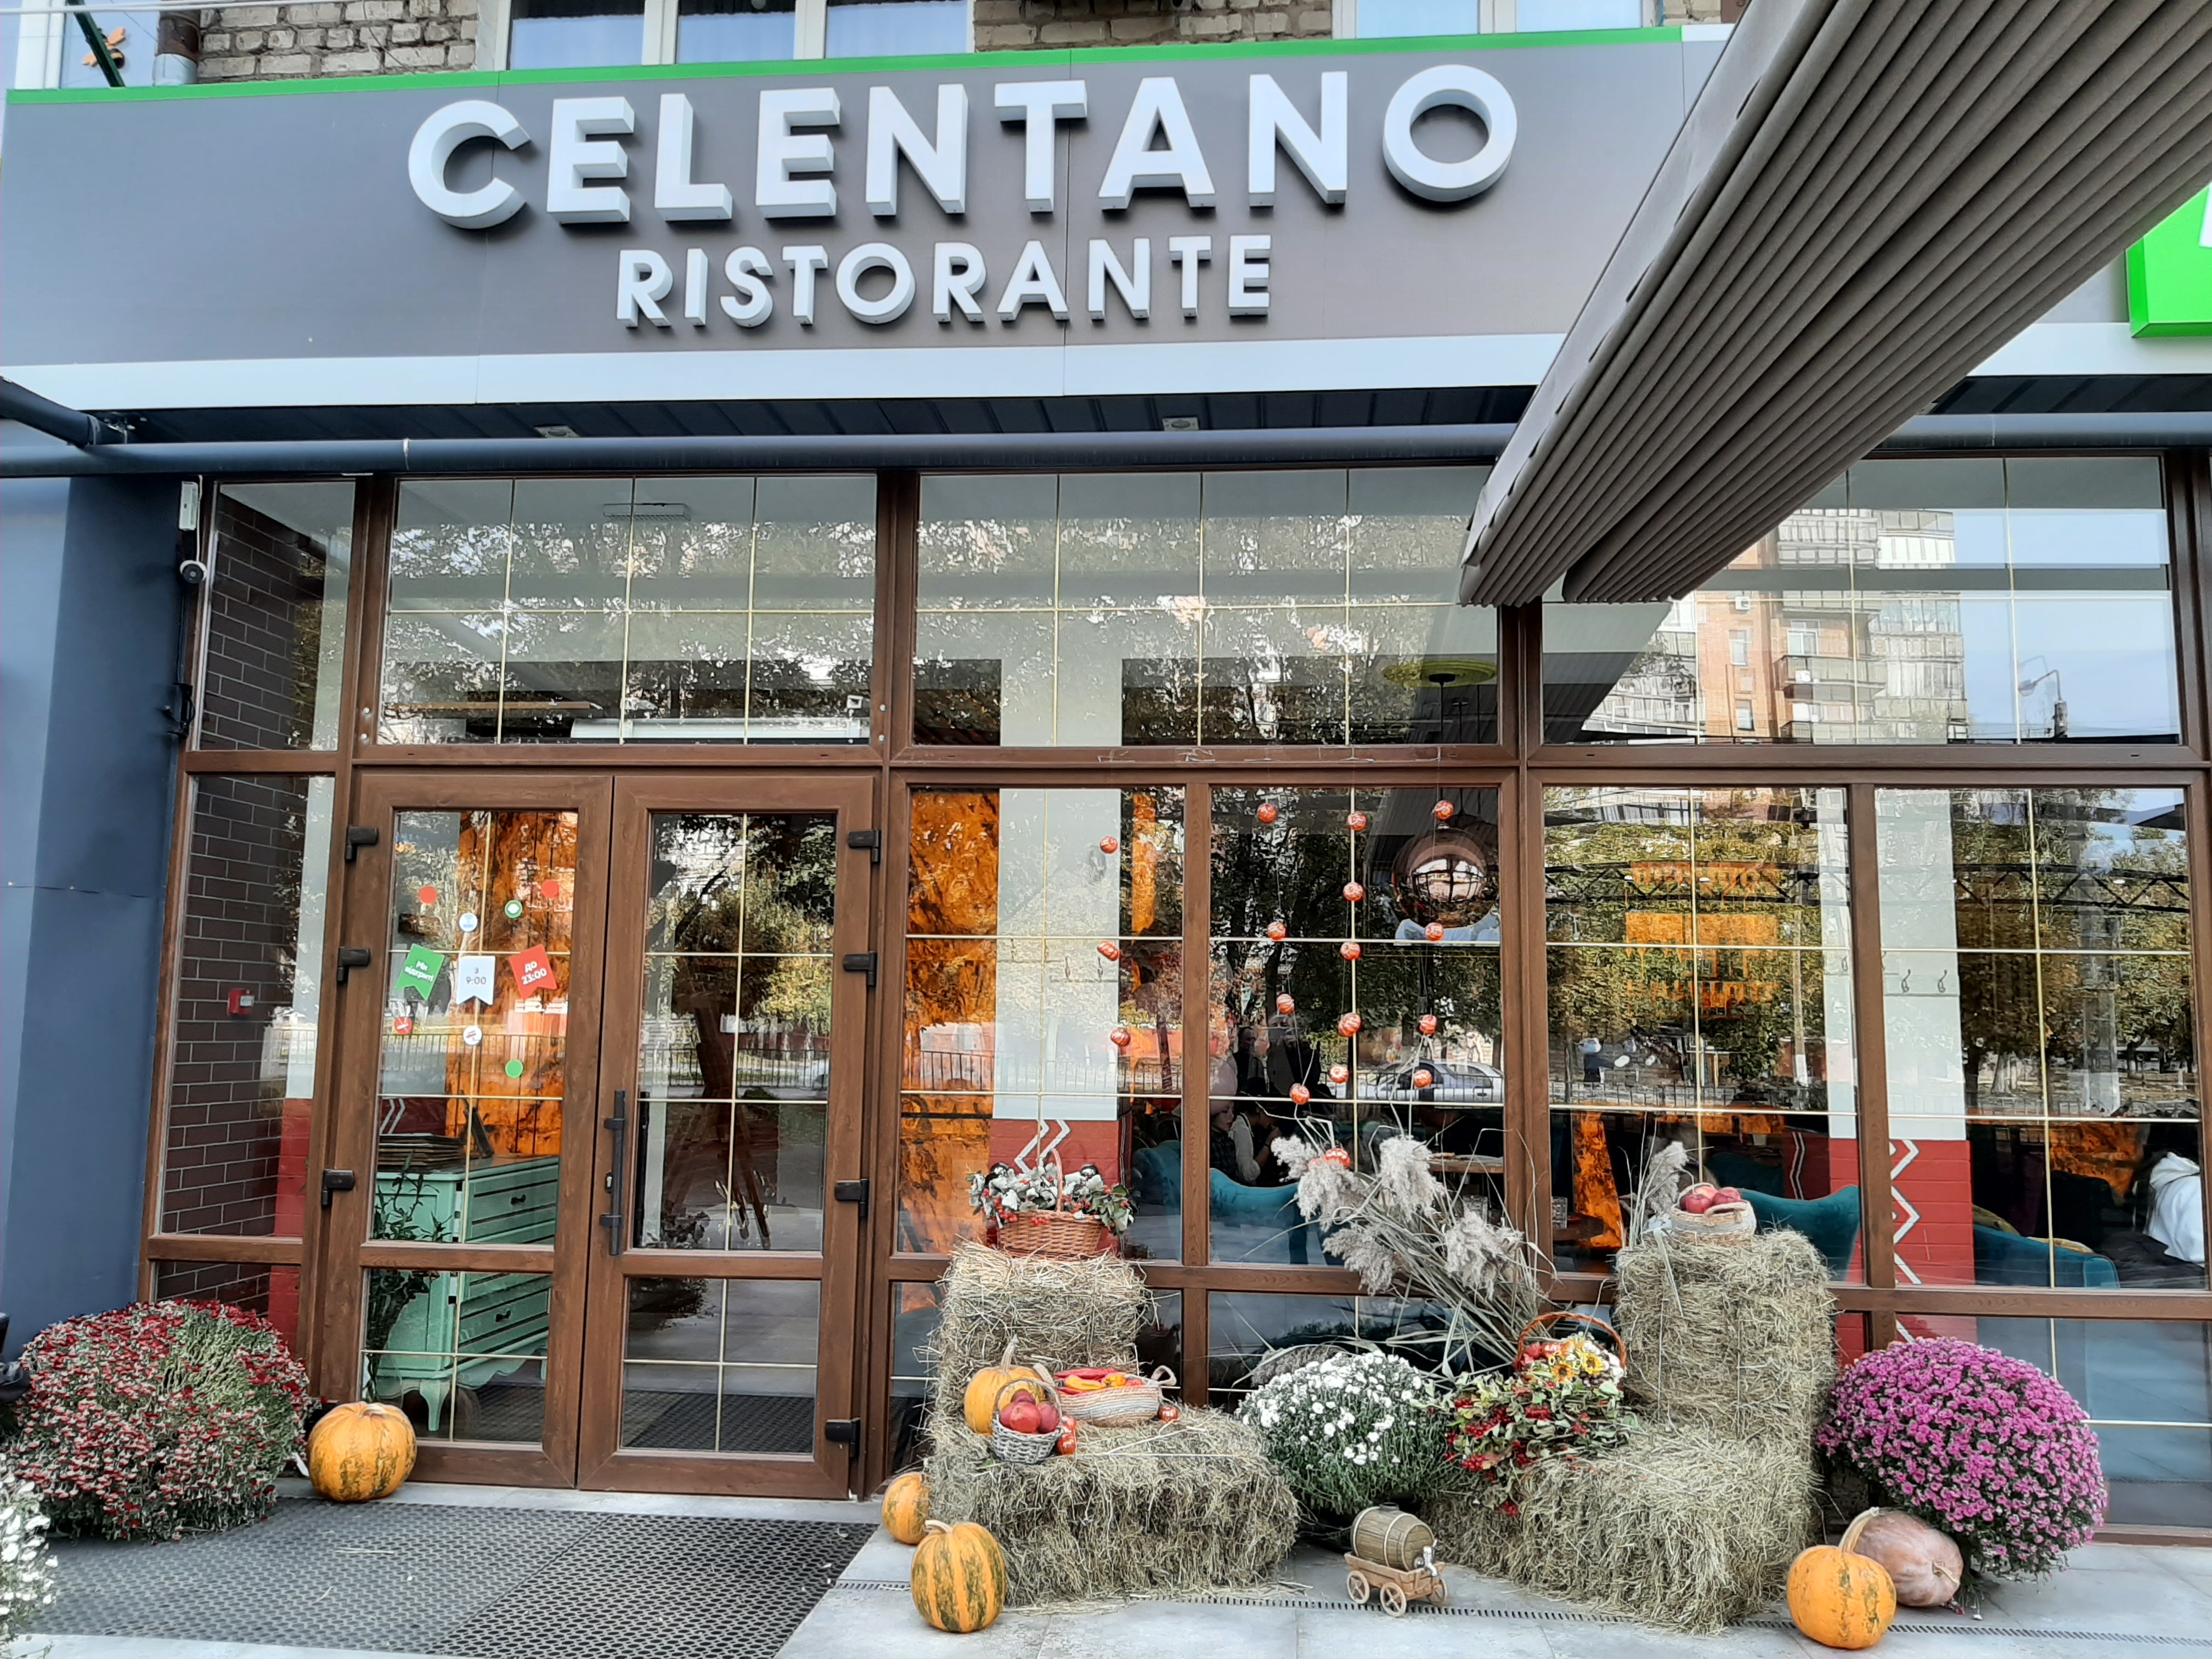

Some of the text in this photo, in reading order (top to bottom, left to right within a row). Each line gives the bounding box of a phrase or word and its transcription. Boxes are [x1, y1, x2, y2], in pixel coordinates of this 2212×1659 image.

[408, 65, 1517, 226] CELENTANO
[617, 235, 1271, 328] RISTORANTE
[466, 977, 487, 985] 9:00
[521, 968, 547, 985] 23:00
